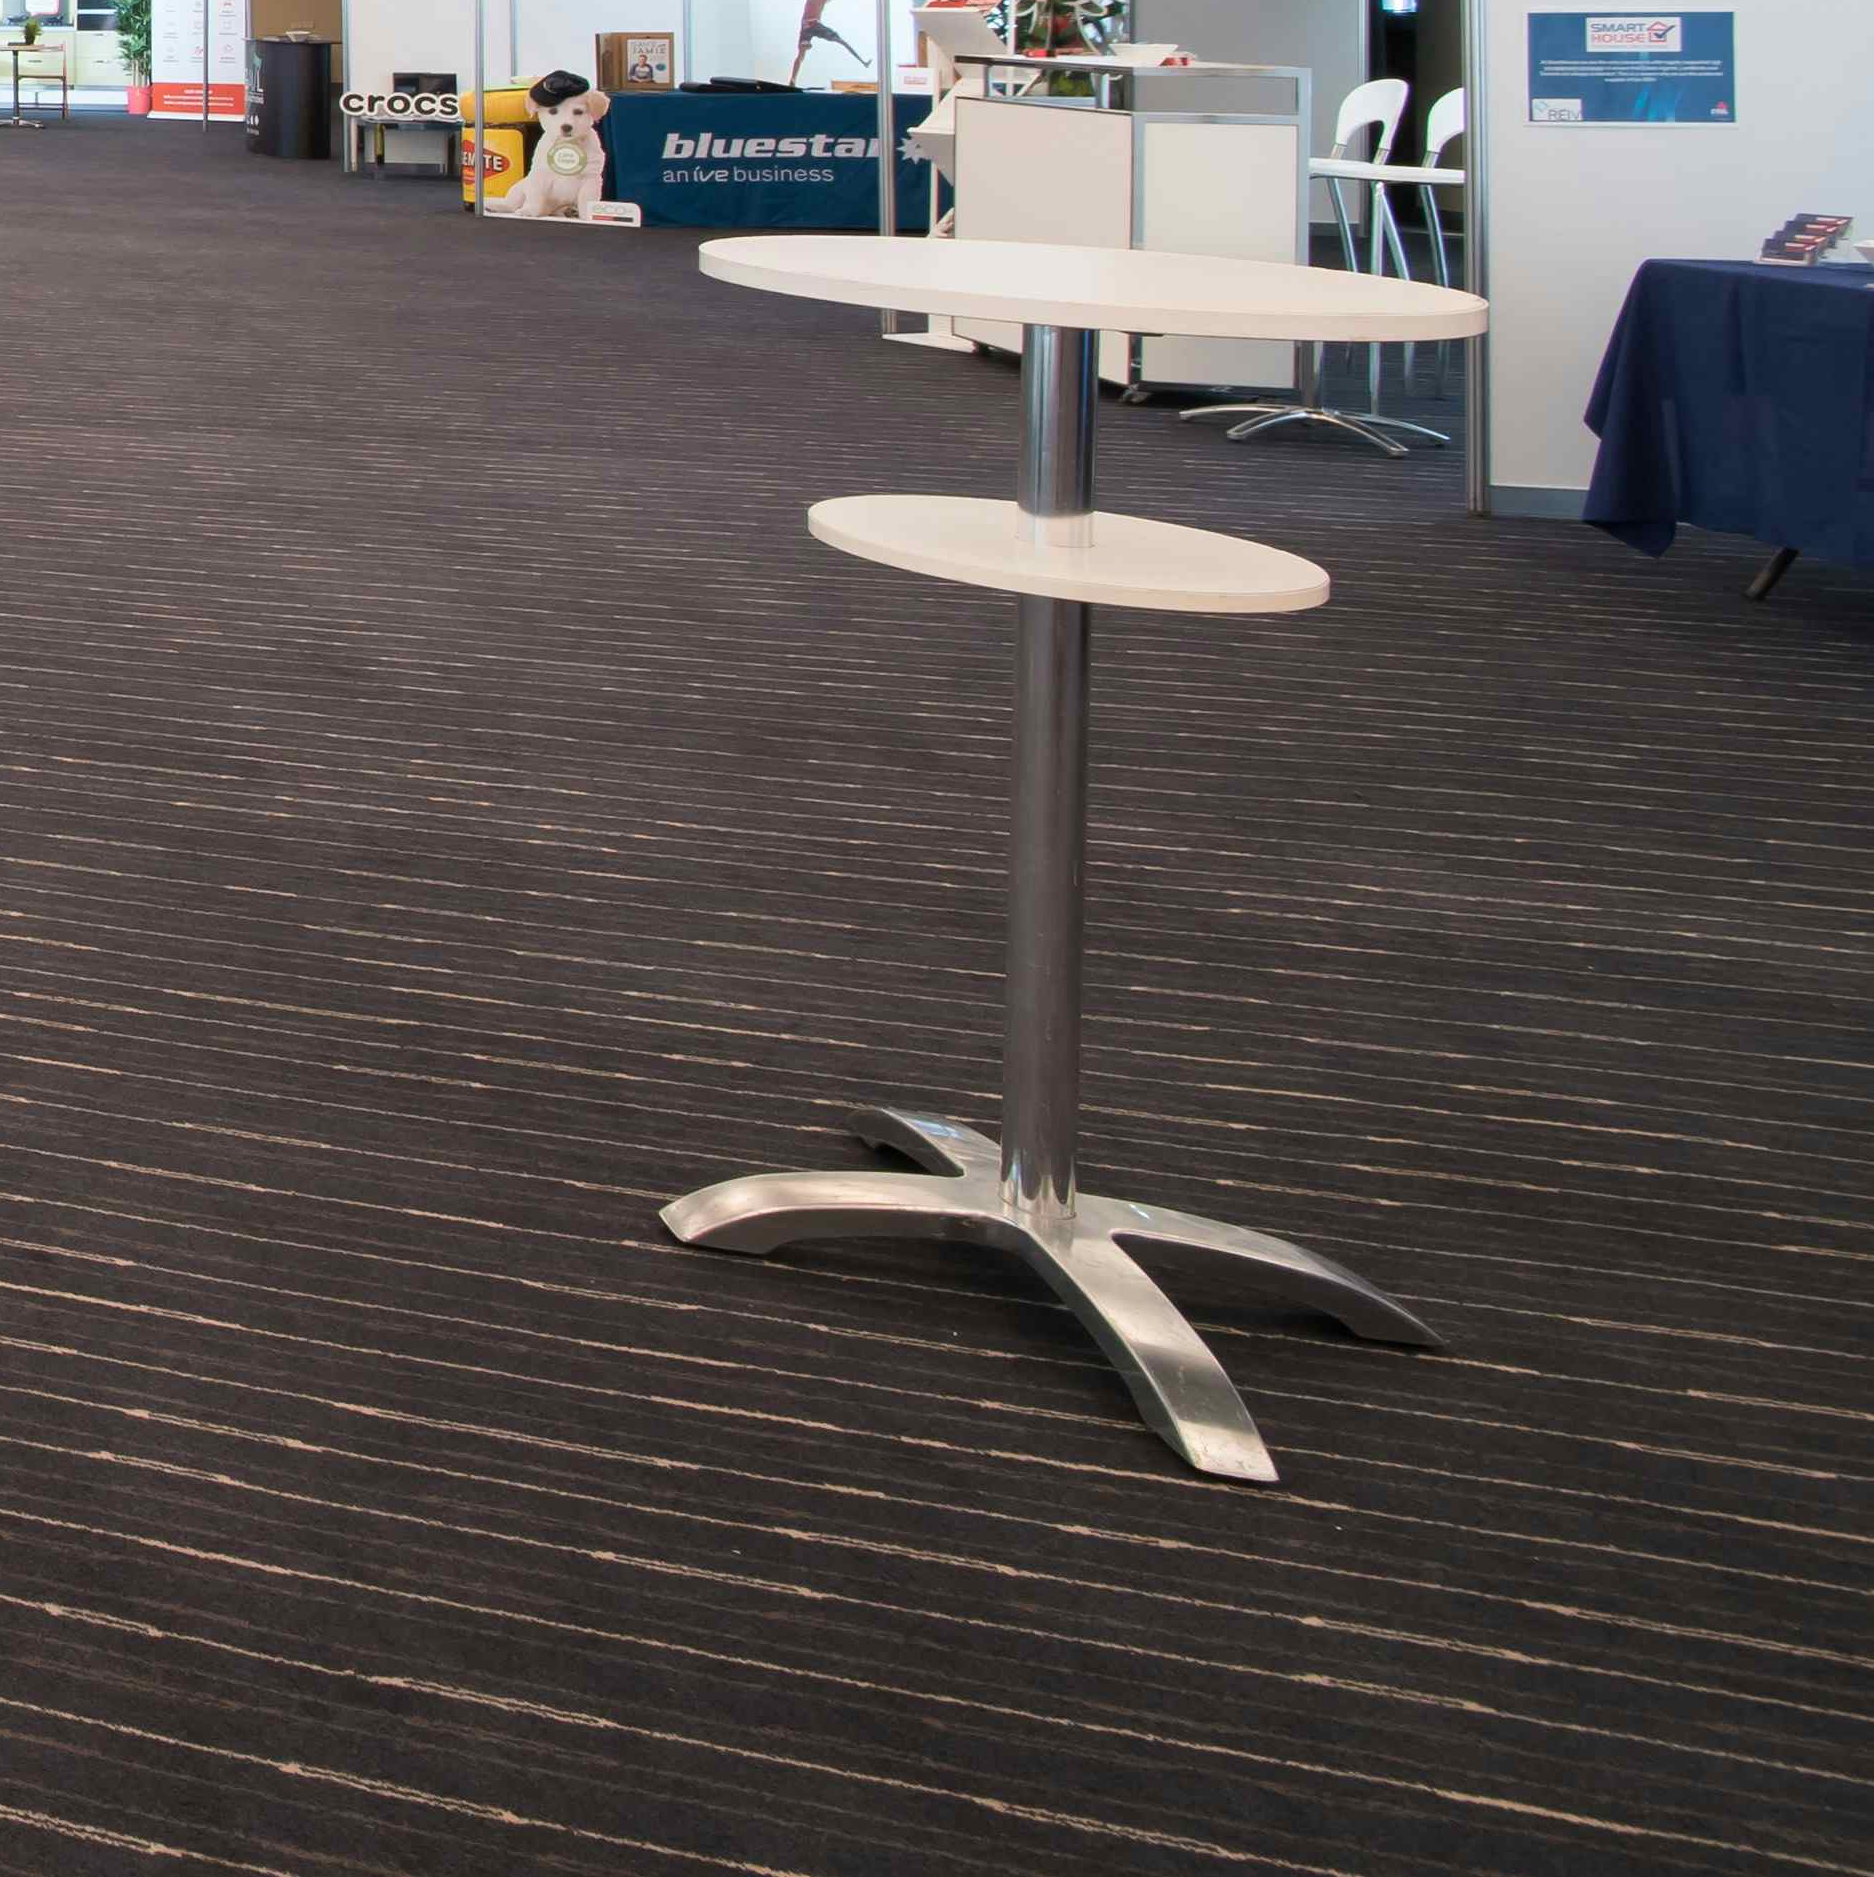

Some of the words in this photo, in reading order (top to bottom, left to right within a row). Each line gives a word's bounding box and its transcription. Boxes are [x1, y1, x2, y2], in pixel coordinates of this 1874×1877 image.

[1590, 23, 1646, 33] SMART
[1591, 33, 1645, 44] HOUSE
[341, 93, 458, 116] crocs
[662, 169, 689, 182] an
[734, 166, 834, 182] business
